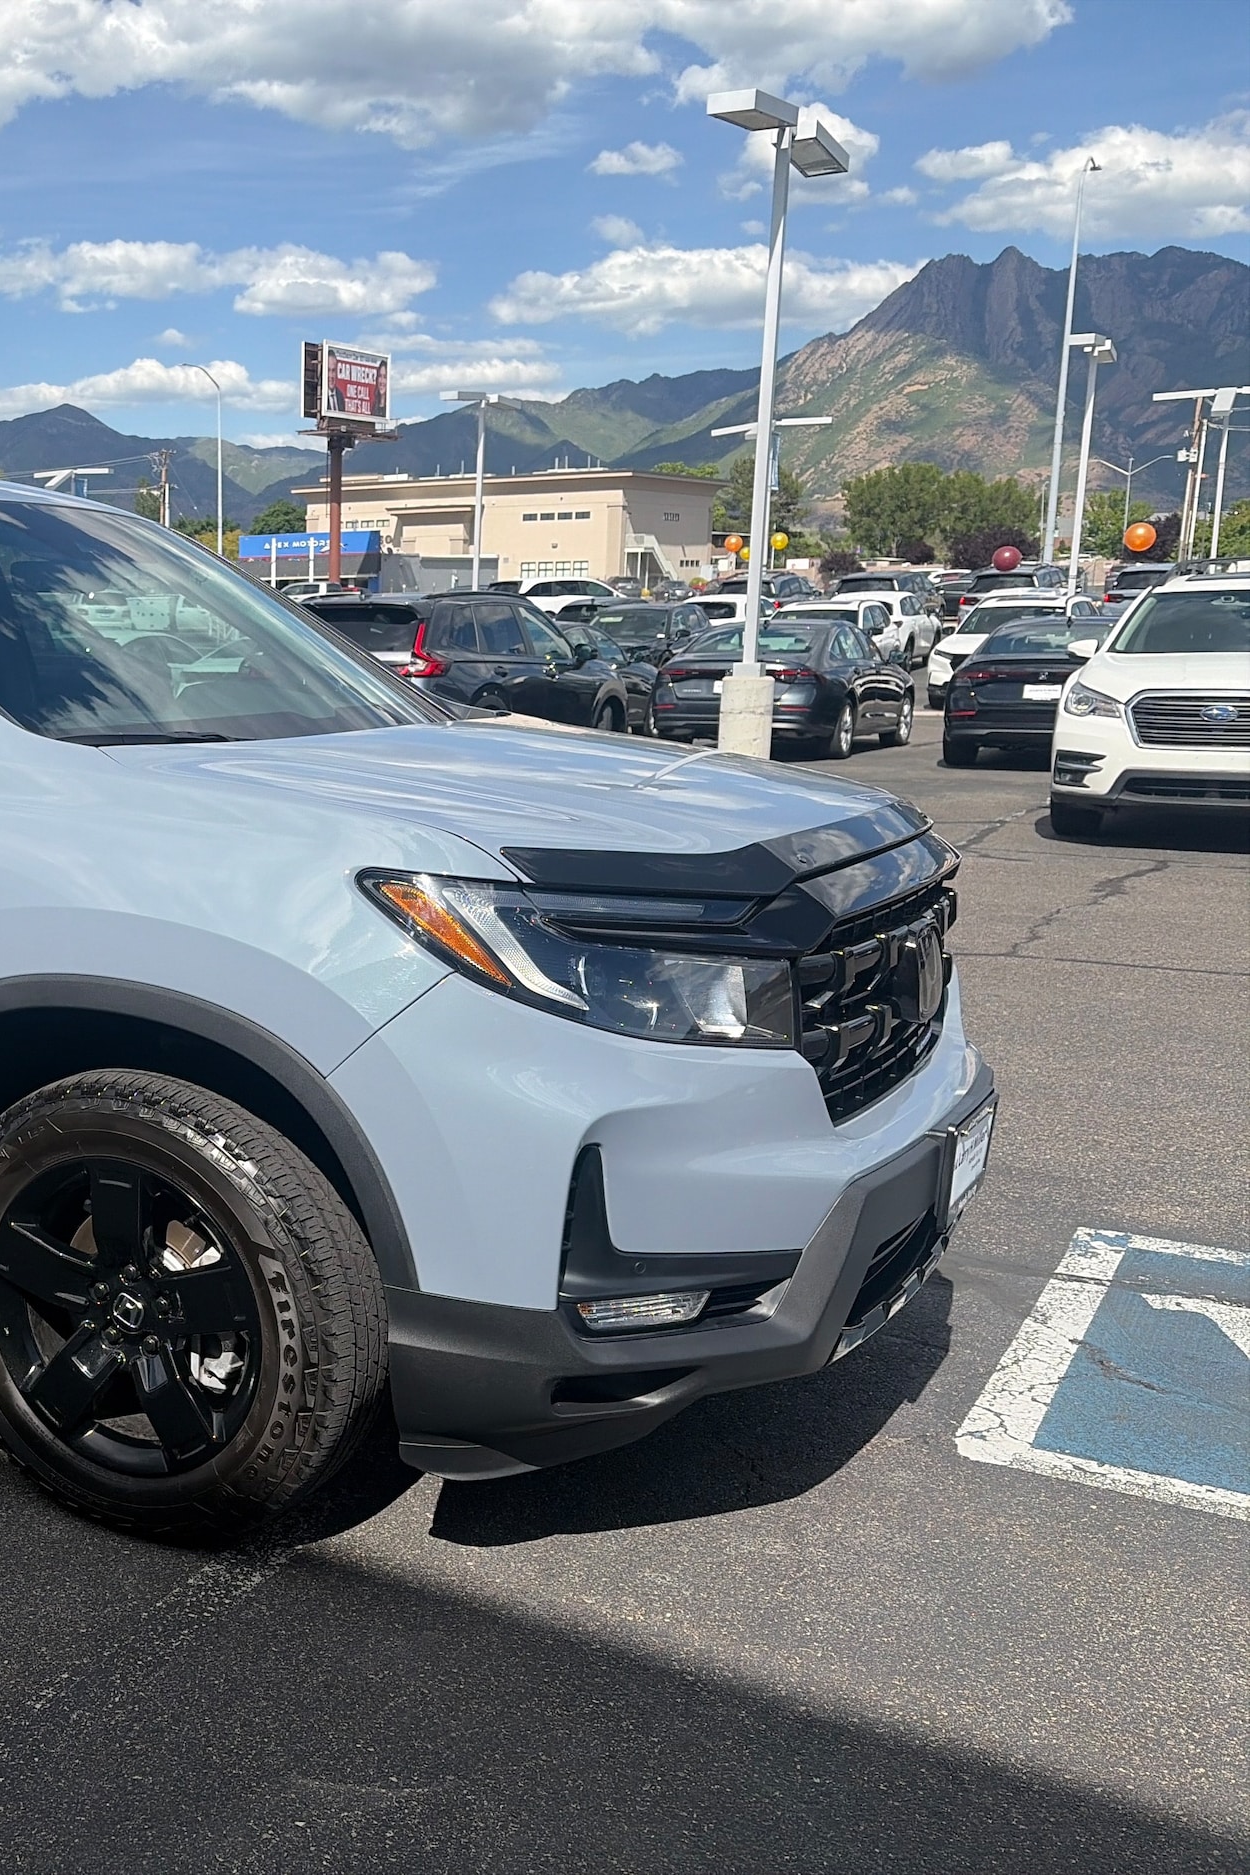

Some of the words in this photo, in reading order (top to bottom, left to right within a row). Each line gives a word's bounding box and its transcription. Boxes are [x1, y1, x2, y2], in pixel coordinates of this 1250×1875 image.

[337, 362, 350, 380] CAR
[351, 365, 377, 385] WRECK?
[347, 384, 357, 398] ONE
[357, 386, 370, 400] CALL
[362, 401, 371, 414] ALL
[263, 541, 289, 549] AEX
[244, 1270, 298, 1482] Firestone
